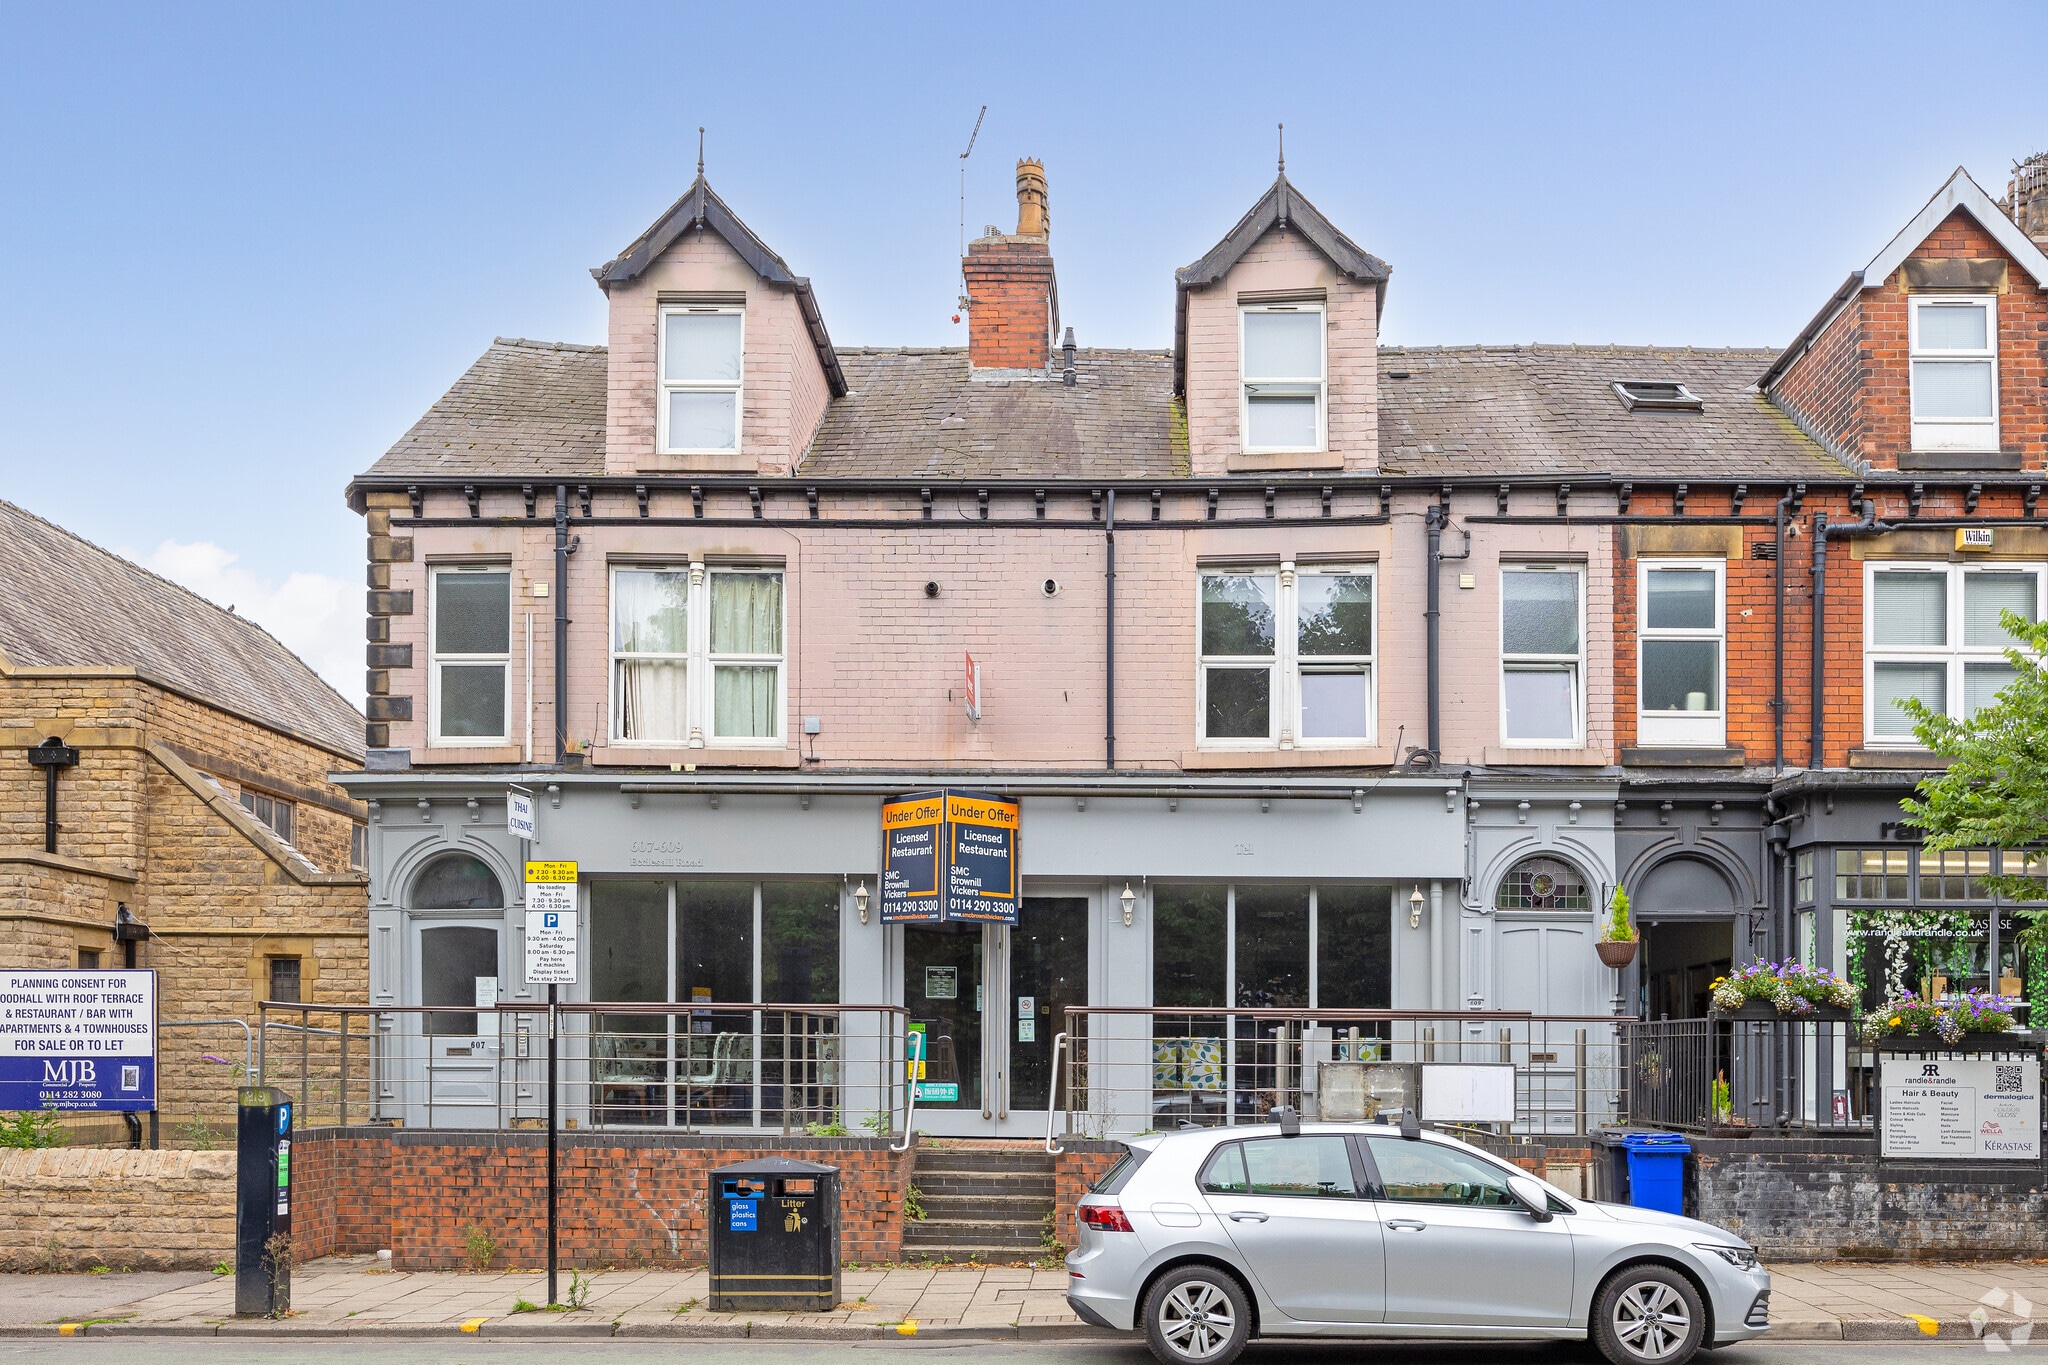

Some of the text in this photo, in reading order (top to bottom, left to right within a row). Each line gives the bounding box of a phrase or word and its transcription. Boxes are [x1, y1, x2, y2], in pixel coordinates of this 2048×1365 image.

[1965, 530, 1990, 542] Wilkin
[514, 801, 528, 814] THAI
[950, 804, 1014, 822] Under Offer
[886, 806, 940, 824] Under Offer
[510, 817, 533, 832] CUISINE
[896, 831, 929, 844] Licensed
[964, 830, 1002, 844] Licensed
[630, 841, 684, 854] 607-609
[892, 845, 932, 858] Restaurant
[959, 843, 1008, 858] Restaurant
[676, 857, 704, 868] Road
[884, 870, 900, 880] SMC
[950, 866, 970, 876] SMC
[884, 880, 910, 889] Brownill
[950, 876, 982, 887] Brownill
[884, 890, 907, 898] Vickers
[950, 886, 979, 896] Vickers
[884, 900, 938, 914] 0114 290 3300
[950, 898, 1014, 914] 0114 290 3300
[548, 915, 556, 926] P
[950, 912, 1015, 921] www.smcbrownillvickers.com
[11, 978, 127, 989] PLANNING CONSENT FOR
[46, 994, 70, 1004] WITH
[73, 994, 98, 1004] ROOF
[101, 994, 144, 1004] TERRACE
[5, 1009, 133, 1019] & RESTAURANT / BAR WITH
[0, 1024, 148, 1034] APARTMENTS & 4 TOWNHOUSES
[14, 1040, 124, 1051] FOR SALE OR TO LET
[42, 1060, 96, 1087] MJB
[39, 1090, 102, 1098] 0114 282 3080
[1931, 1090, 1959, 1098] Beauty
[280, 1107, 287, 1129] P
[1985, 1140, 2032, 1151] KÉRASTASE
[731, 1203, 749, 1211] glass
[781, 1200, 805, 1208] Litter
